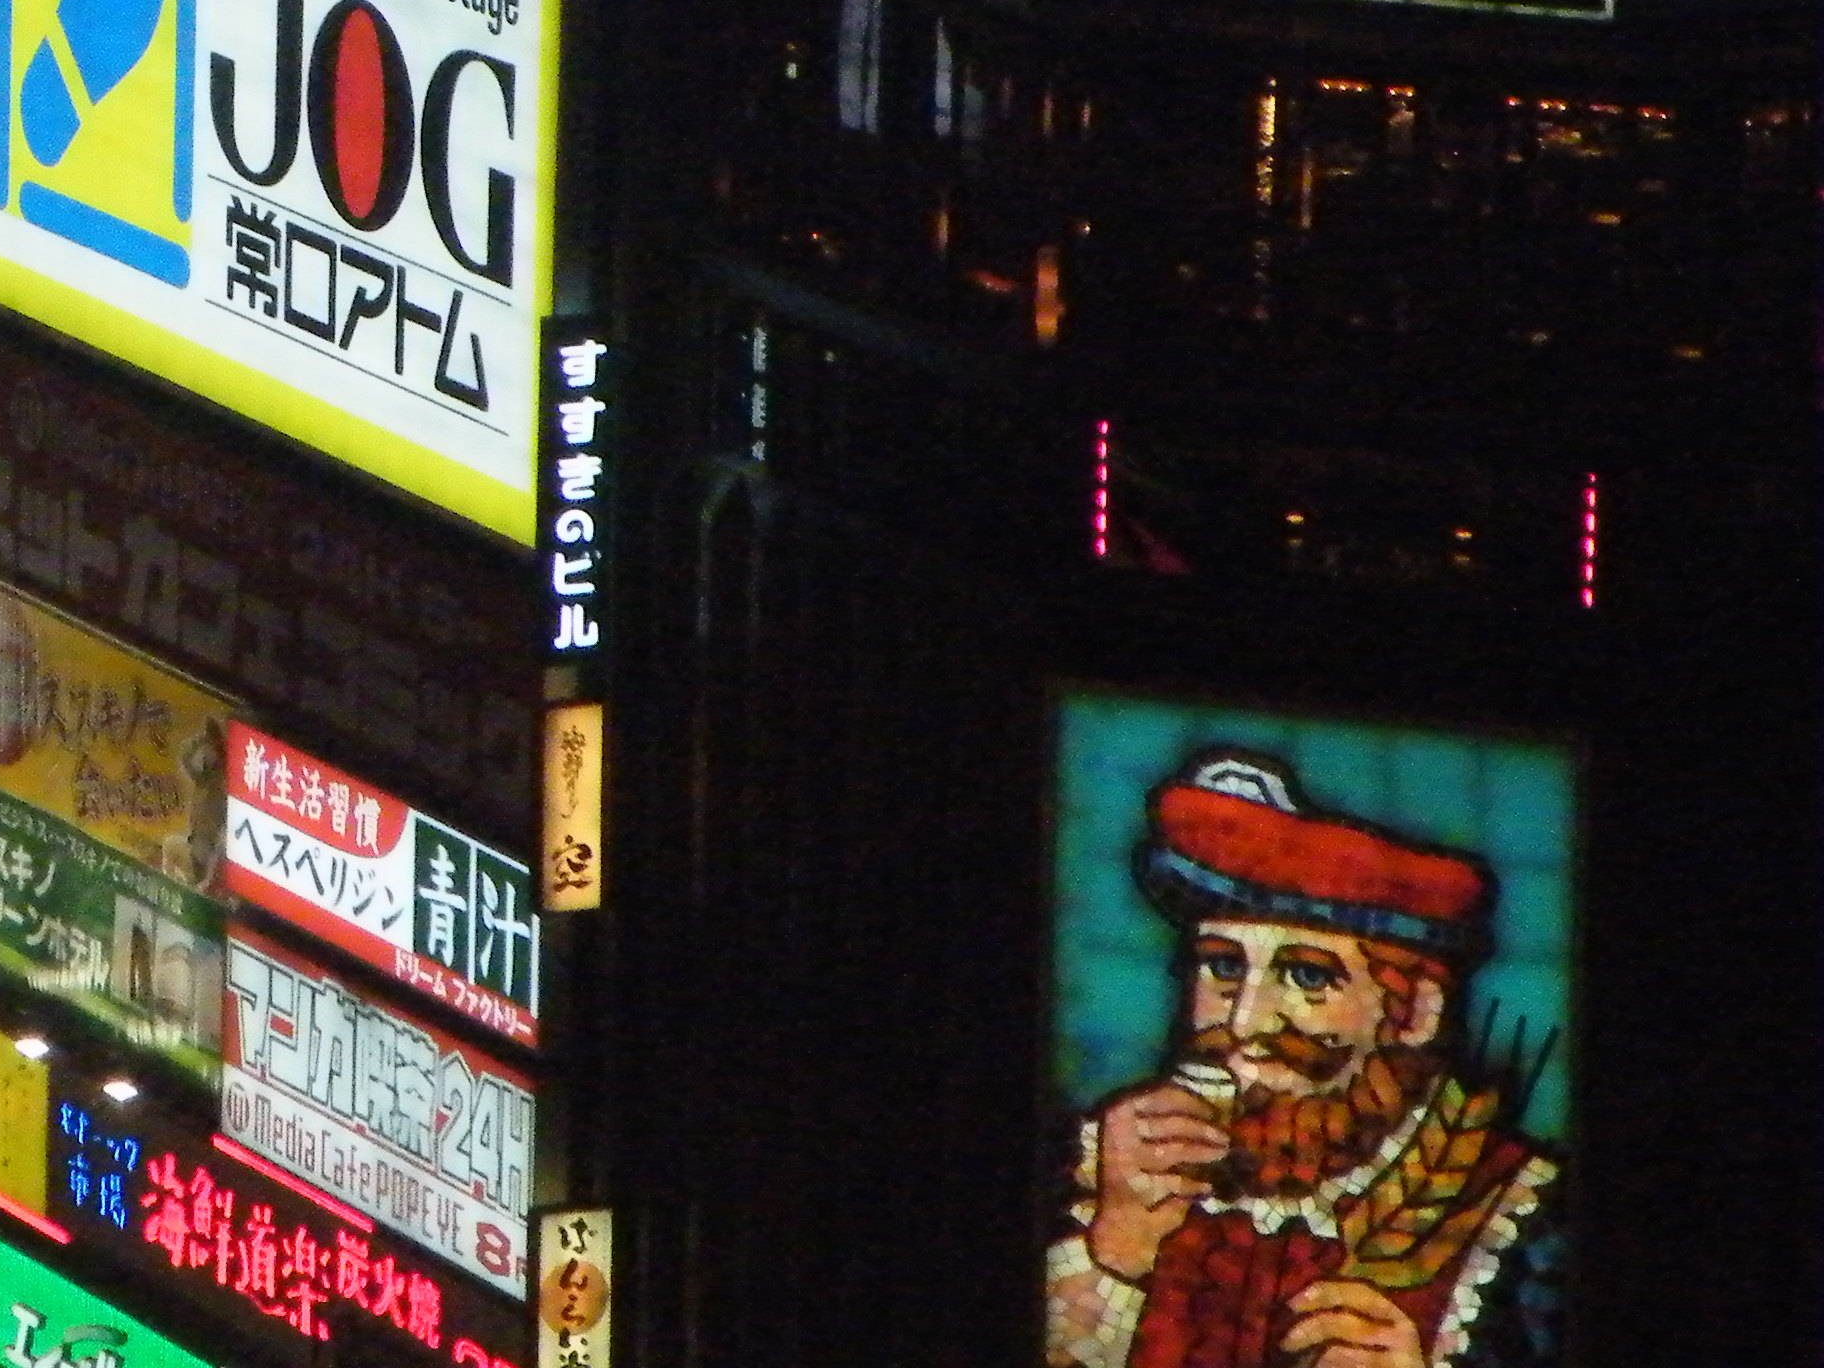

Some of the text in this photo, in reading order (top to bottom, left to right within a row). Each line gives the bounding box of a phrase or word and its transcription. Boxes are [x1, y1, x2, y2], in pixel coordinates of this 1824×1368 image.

[224, 194, 490, 412] 常口アトム
[551, 338, 608, 651] すすきのビル
[234, 816, 406, 931] ヘスペリジン
[242, 736, 381, 856] 新生活習慣
[417, 844, 532, 999] 青汁
[252, 1093, 317, 1173] Media
[318, 1142, 372, 1205] Cafe
[435, 1048, 536, 1224] 24H
[140, 1151, 330, 1342] 海鮮道楽
